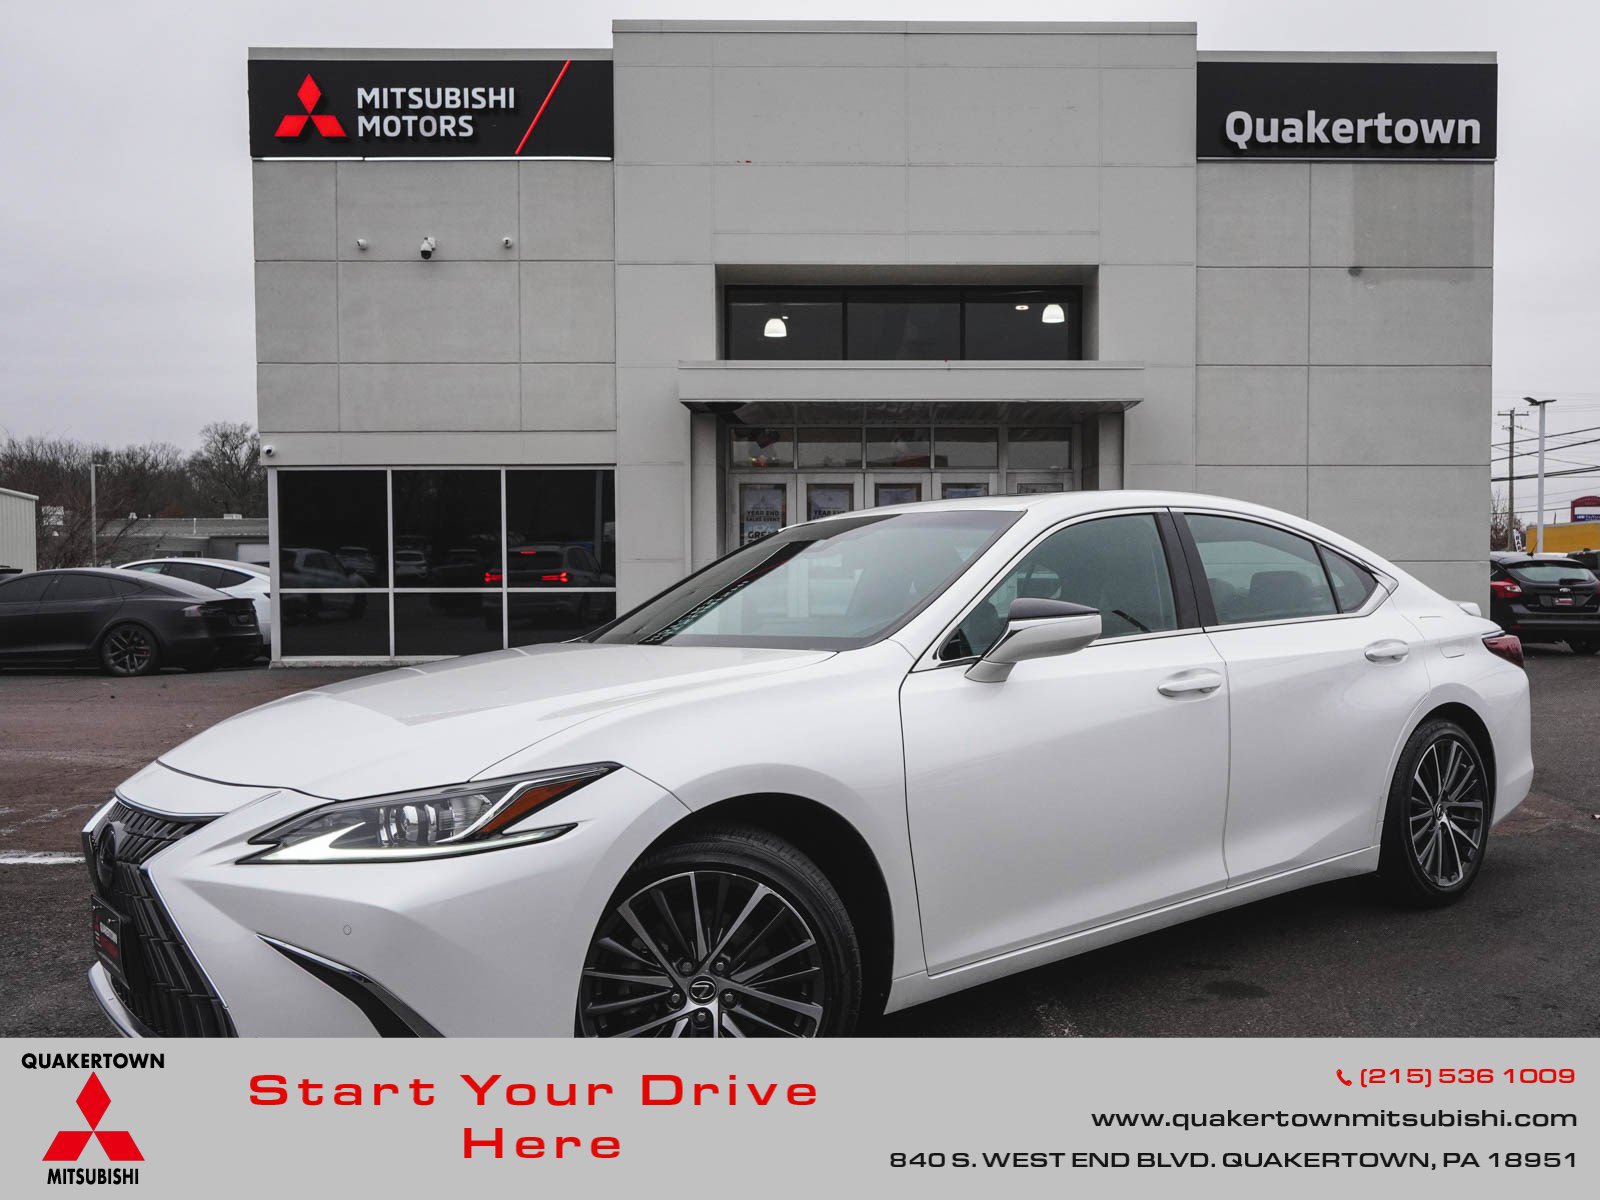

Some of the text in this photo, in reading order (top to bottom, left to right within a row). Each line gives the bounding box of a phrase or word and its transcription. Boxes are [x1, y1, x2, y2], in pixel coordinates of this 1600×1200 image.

[357, 87, 515, 110] MITSUBISHI
[357, 115, 474, 138] MOTORS
[1225, 109, 1481, 150] Quakertown
